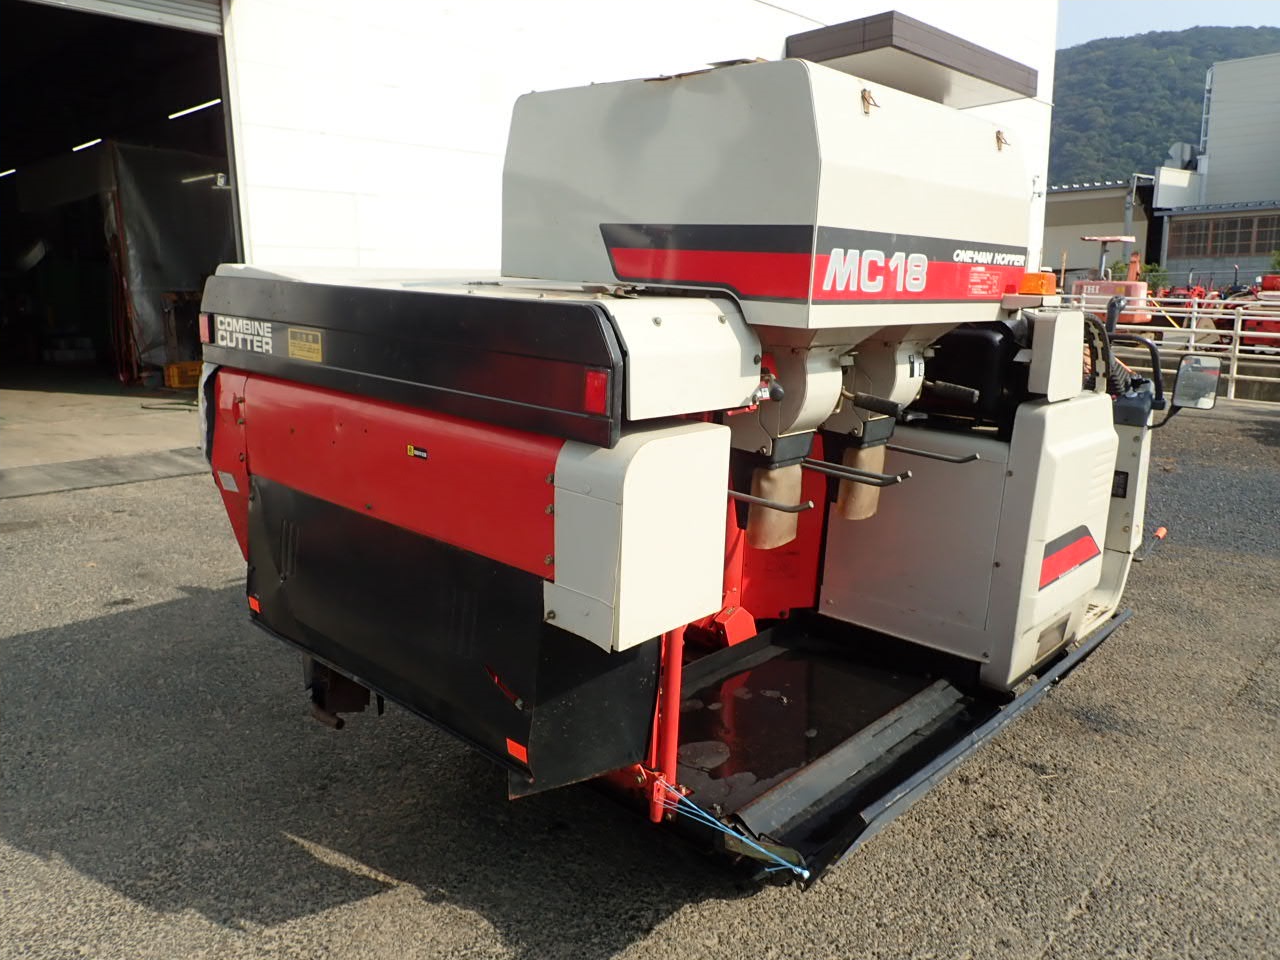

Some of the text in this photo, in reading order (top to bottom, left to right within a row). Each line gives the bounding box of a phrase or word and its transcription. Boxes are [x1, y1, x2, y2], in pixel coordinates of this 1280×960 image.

[994, 252, 1026, 267] HOPPER
[217, 316, 273, 338] COMBINE
[217, 330, 273, 355] CUTTER
